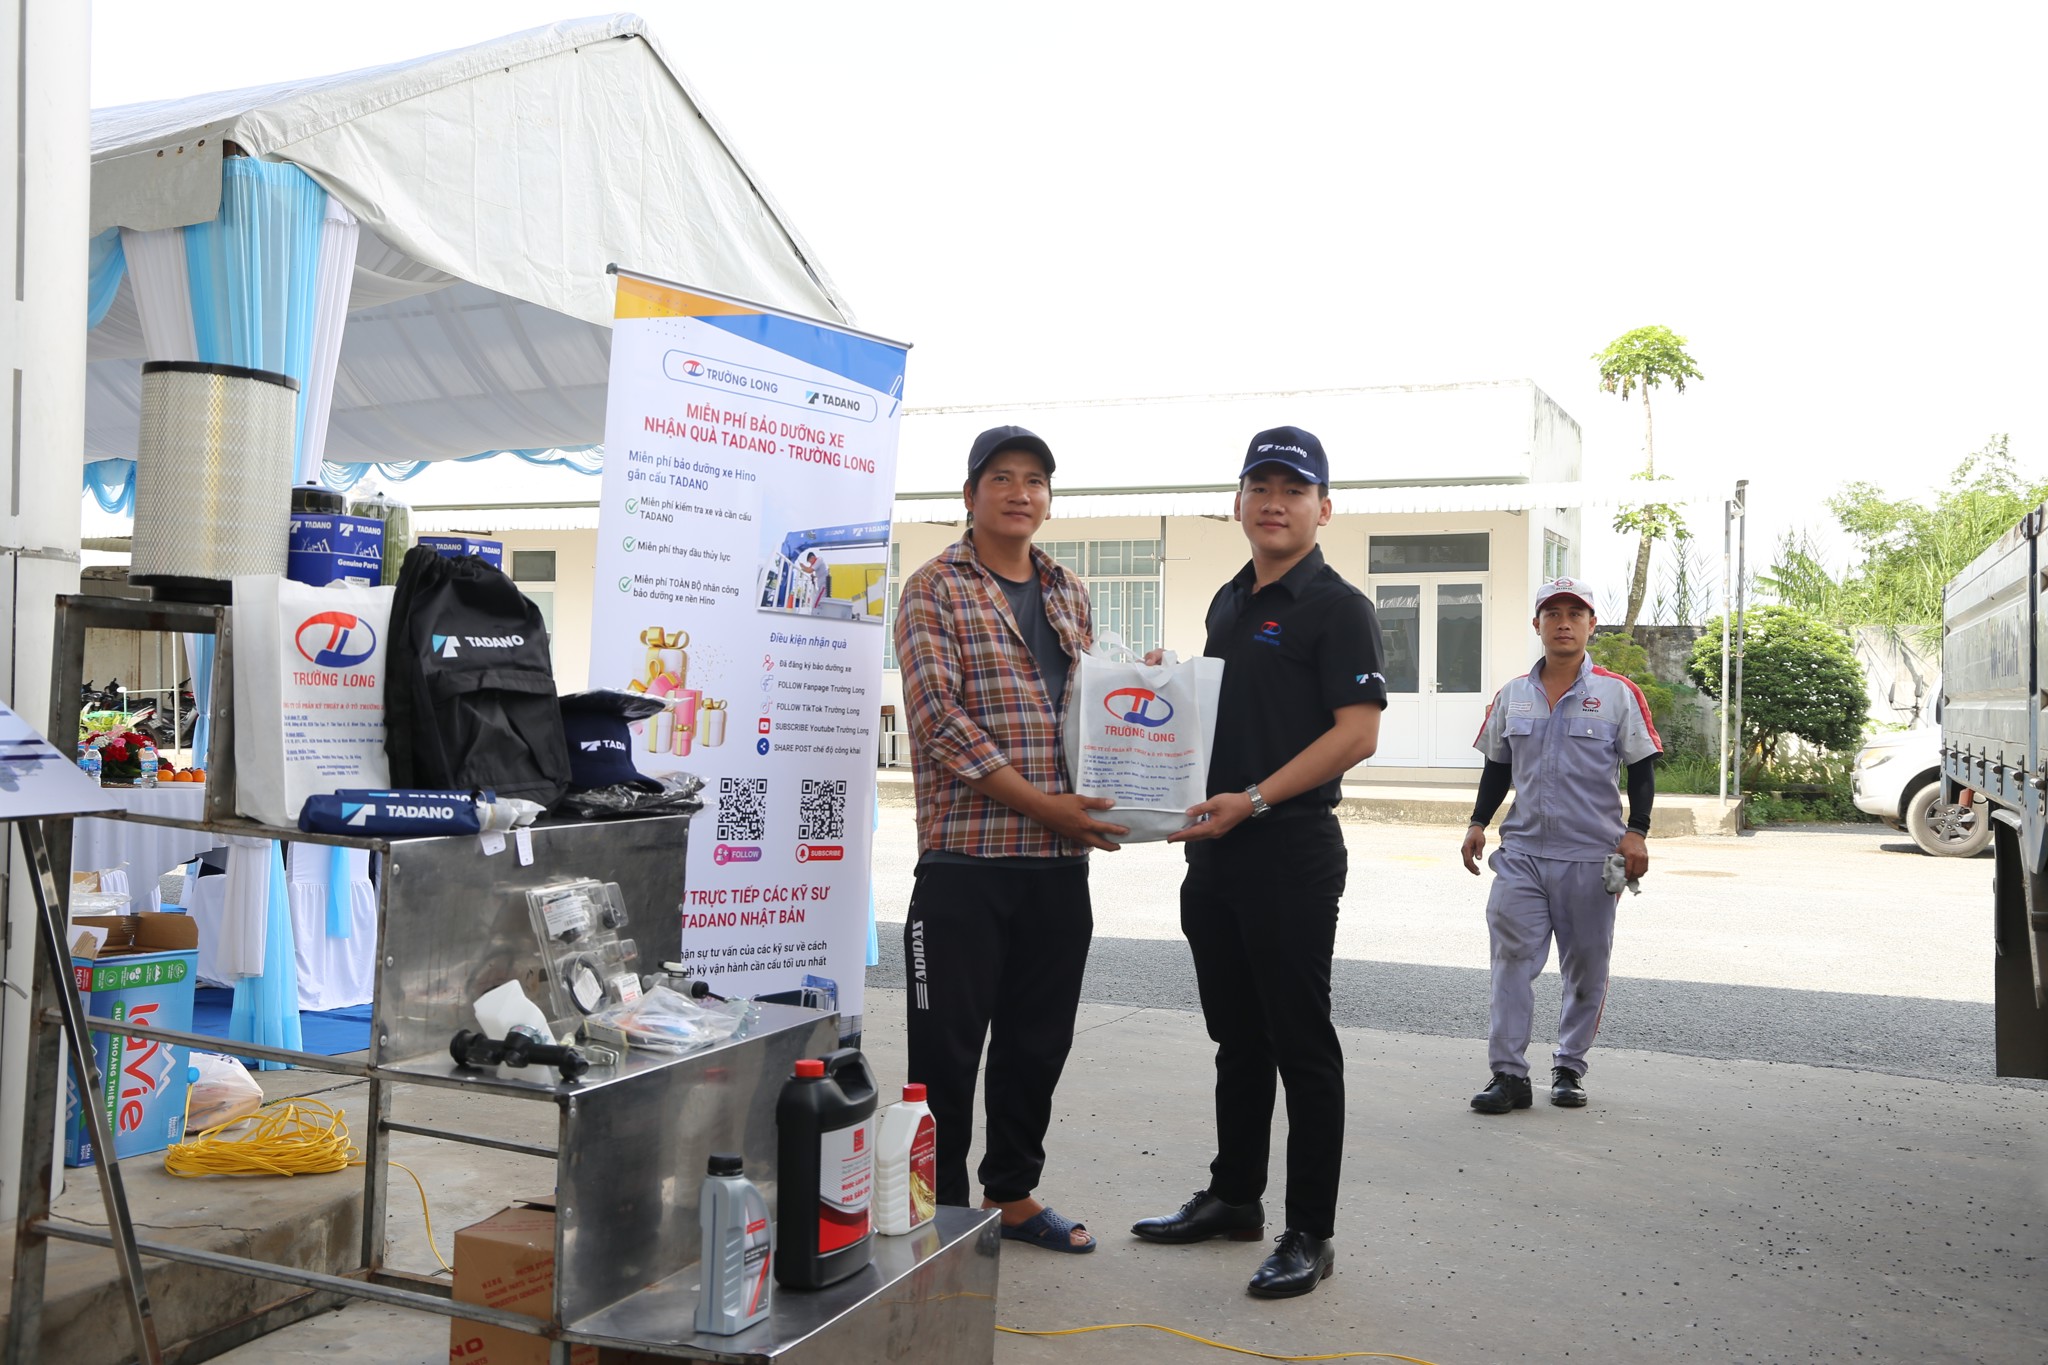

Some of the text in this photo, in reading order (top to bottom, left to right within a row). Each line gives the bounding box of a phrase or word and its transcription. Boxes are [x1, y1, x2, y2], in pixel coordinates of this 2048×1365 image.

[707, 368, 778, 393] TRƯỜNG LONG
[822, 394, 860, 411] TADANO
[686, 402, 845, 448] MIỄN PHÍ BẢO DƯỠNG XE
[644, 415, 686, 438] NHẬN
[690, 425, 717, 444] QUÀ
[722, 431, 776, 455] TADANO
[788, 444, 840, 466] TRƯỜNG
[844, 455, 875, 474] LONG
[1274, 445, 1308, 458] TADANO
[656, 454, 671, 468] phí
[674, 457, 690, 470] bảo
[692, 461, 720, 478] dưỡng
[722, 468, 733, 478] xe
[735, 469, 756, 482] Hino
[669, 474, 708, 490] TADANO
[640, 510, 674, 523] TADANO
[662, 500, 674, 510] phí
[694, 505, 704, 514] tra
[705, 508, 714, 516] xe
[714, 508, 723, 517] và
[304, 521, 332, 530] TADANO
[357, 526, 382, 536] TADANO
[865, 525, 889, 533] TADANO
[436, 543, 462, 551] TADANO
[482, 546, 501, 555] TADANO
[658, 544, 670, 554] phí
[672, 546, 688, 558] thay
[703, 548, 718, 562] thủy
[719, 551, 731, 562] lực
[338, 558, 378, 570] Genuine Parts
[655, 578, 668, 588] phí
[669, 577, 690, 589] TOÀN
[691, 579, 702, 592] BỘ
[702, 583, 720, 592] nhân
[722, 585, 740, 596] công
[633, 588, 648, 598] bảo
[650, 590, 674, 603] dưỡng
[674, 594, 684, 602] xe
[699, 595, 716, 606] Hino
[464, 634, 525, 649] TADANO
[790, 634, 806, 647] kiện
[808, 636, 830, 648] nhận
[804, 662, 812, 670] ký
[812, 662, 824, 670] bảo
[293, 669, 376, 688] TRƯỜNG LONG
[778, 680, 866, 696] FOLLOW Fanpage Trường Long
[776, 702, 860, 716] FOLLOW TikTok Trường Long
[775, 722, 869, 736] SUBSCRIBE Youtube Trường Long
[1105, 724, 1176, 743] TRƯỜNG LONG
[774, 744, 794, 752] SHARE
[795, 744, 812, 752] POST
[825, 745, 834, 754] độ
[849, 746, 861, 754] khai
[386, 804, 454, 820] TADANO
[690, 884, 830, 908] TRỰC TIẾP CÁC KỸ SƯ
[682, 905, 806, 929] TADANO NHẬT BẢN
[696, 950, 708, 960] sự
[710, 949, 720, 958] tư
[722, 945, 738, 957] vấn
[740, 944, 755, 956] của
[756, 943, 771, 954] các
[773, 942, 783, 956] kỹ
[784, 943, 795, 952] sư
[796, 942, 806, 952] về
[807, 940, 827, 951] cách
[912, 920, 927, 981] ADIDAS
[696, 965, 707, 977] kỳ
[710, 963, 725, 976] vận
[726, 961, 748, 974] hành
[750, 958, 766, 971] cần
[796, 959, 807, 967] ưu
[808, 956, 827, 967] nhất
[107, 1080, 116, 1108] THIÊN
